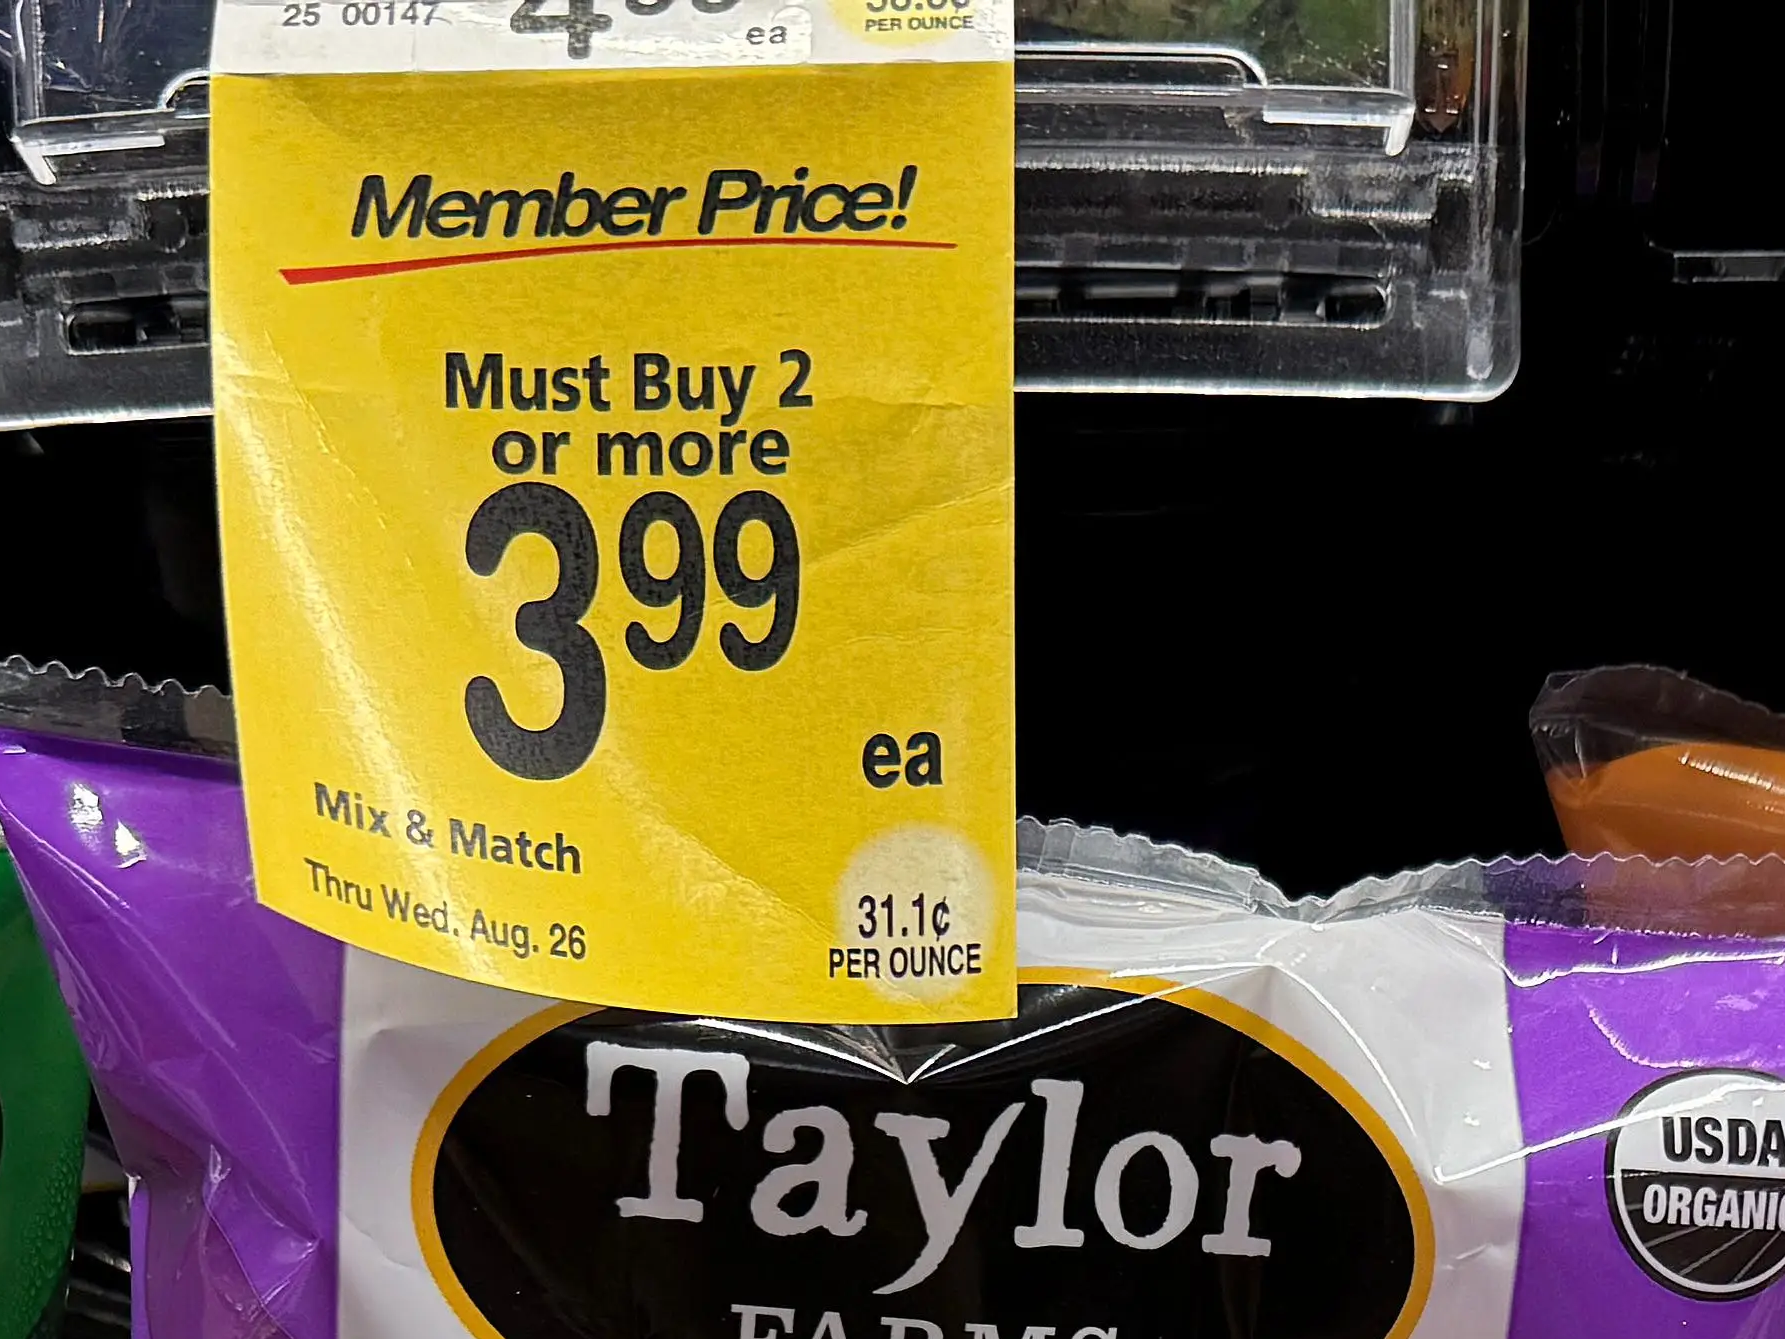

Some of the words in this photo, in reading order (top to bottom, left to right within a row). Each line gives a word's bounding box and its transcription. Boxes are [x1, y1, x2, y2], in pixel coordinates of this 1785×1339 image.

[351, 172, 686, 240] Member
[698, 166, 917, 233] Price!
[445, 353, 608, 410] Must
[633, 355, 756, 424] Buy
[780, 350, 813, 408] 2
[313, 782, 392, 838] Mix
[405, 809, 436, 848] &
[448, 819, 583, 874] Match
[858, 894, 950, 941] 31.1¢
[828, 948, 884, 980] PER
[889, 944, 983, 977] OUNCE
[585, 1040, 1303, 1295] Taylor
